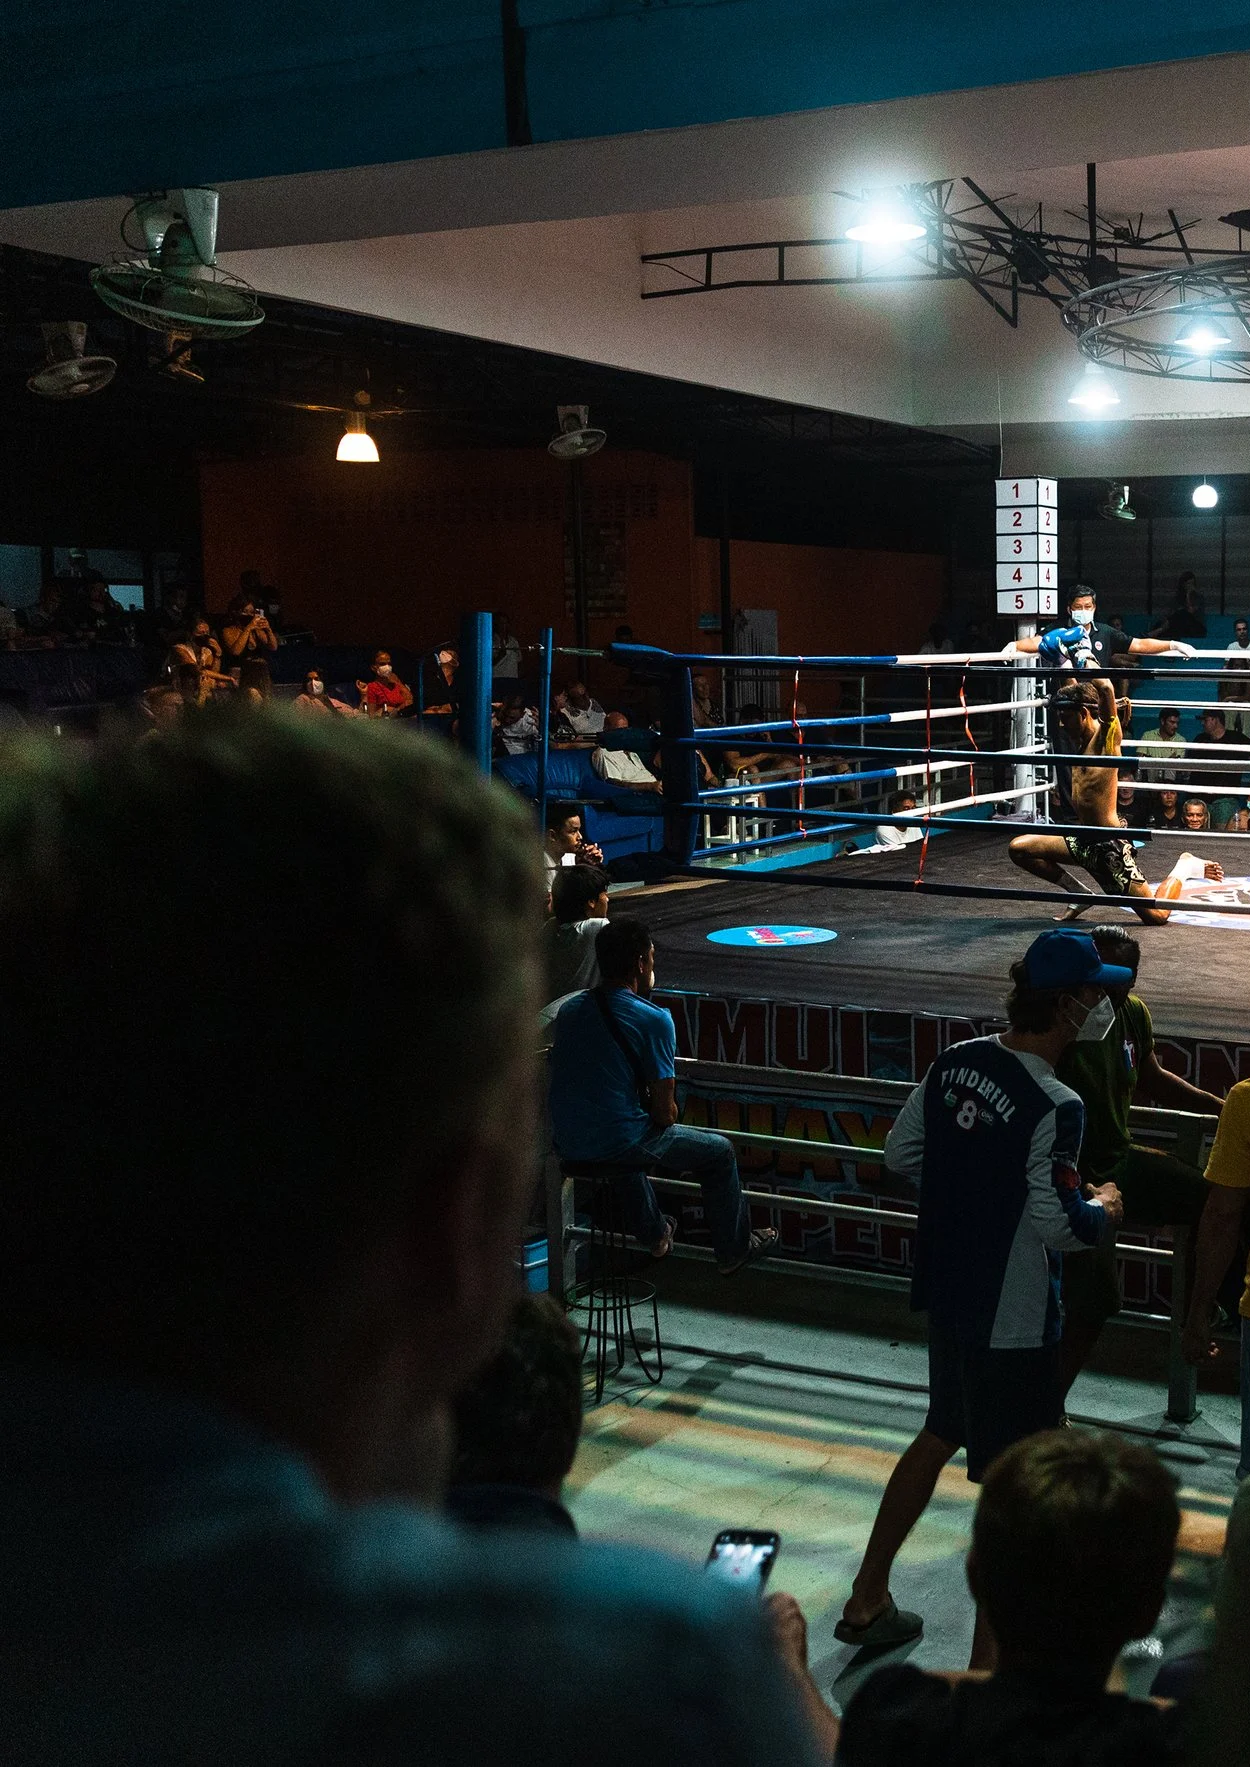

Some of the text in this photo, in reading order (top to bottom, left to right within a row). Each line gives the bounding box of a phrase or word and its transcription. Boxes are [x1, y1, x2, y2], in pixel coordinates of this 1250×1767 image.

[1012, 483, 1019, 498] 1
[1012, 511, 1022, 527] 2
[1013, 539, 1022, 554] 3
[1012, 568, 1022, 583] 4
[1015, 595, 1024, 609] 5
[648, 992, 868, 1077] AMUI
[956, 1099, 978, 1130] 8
